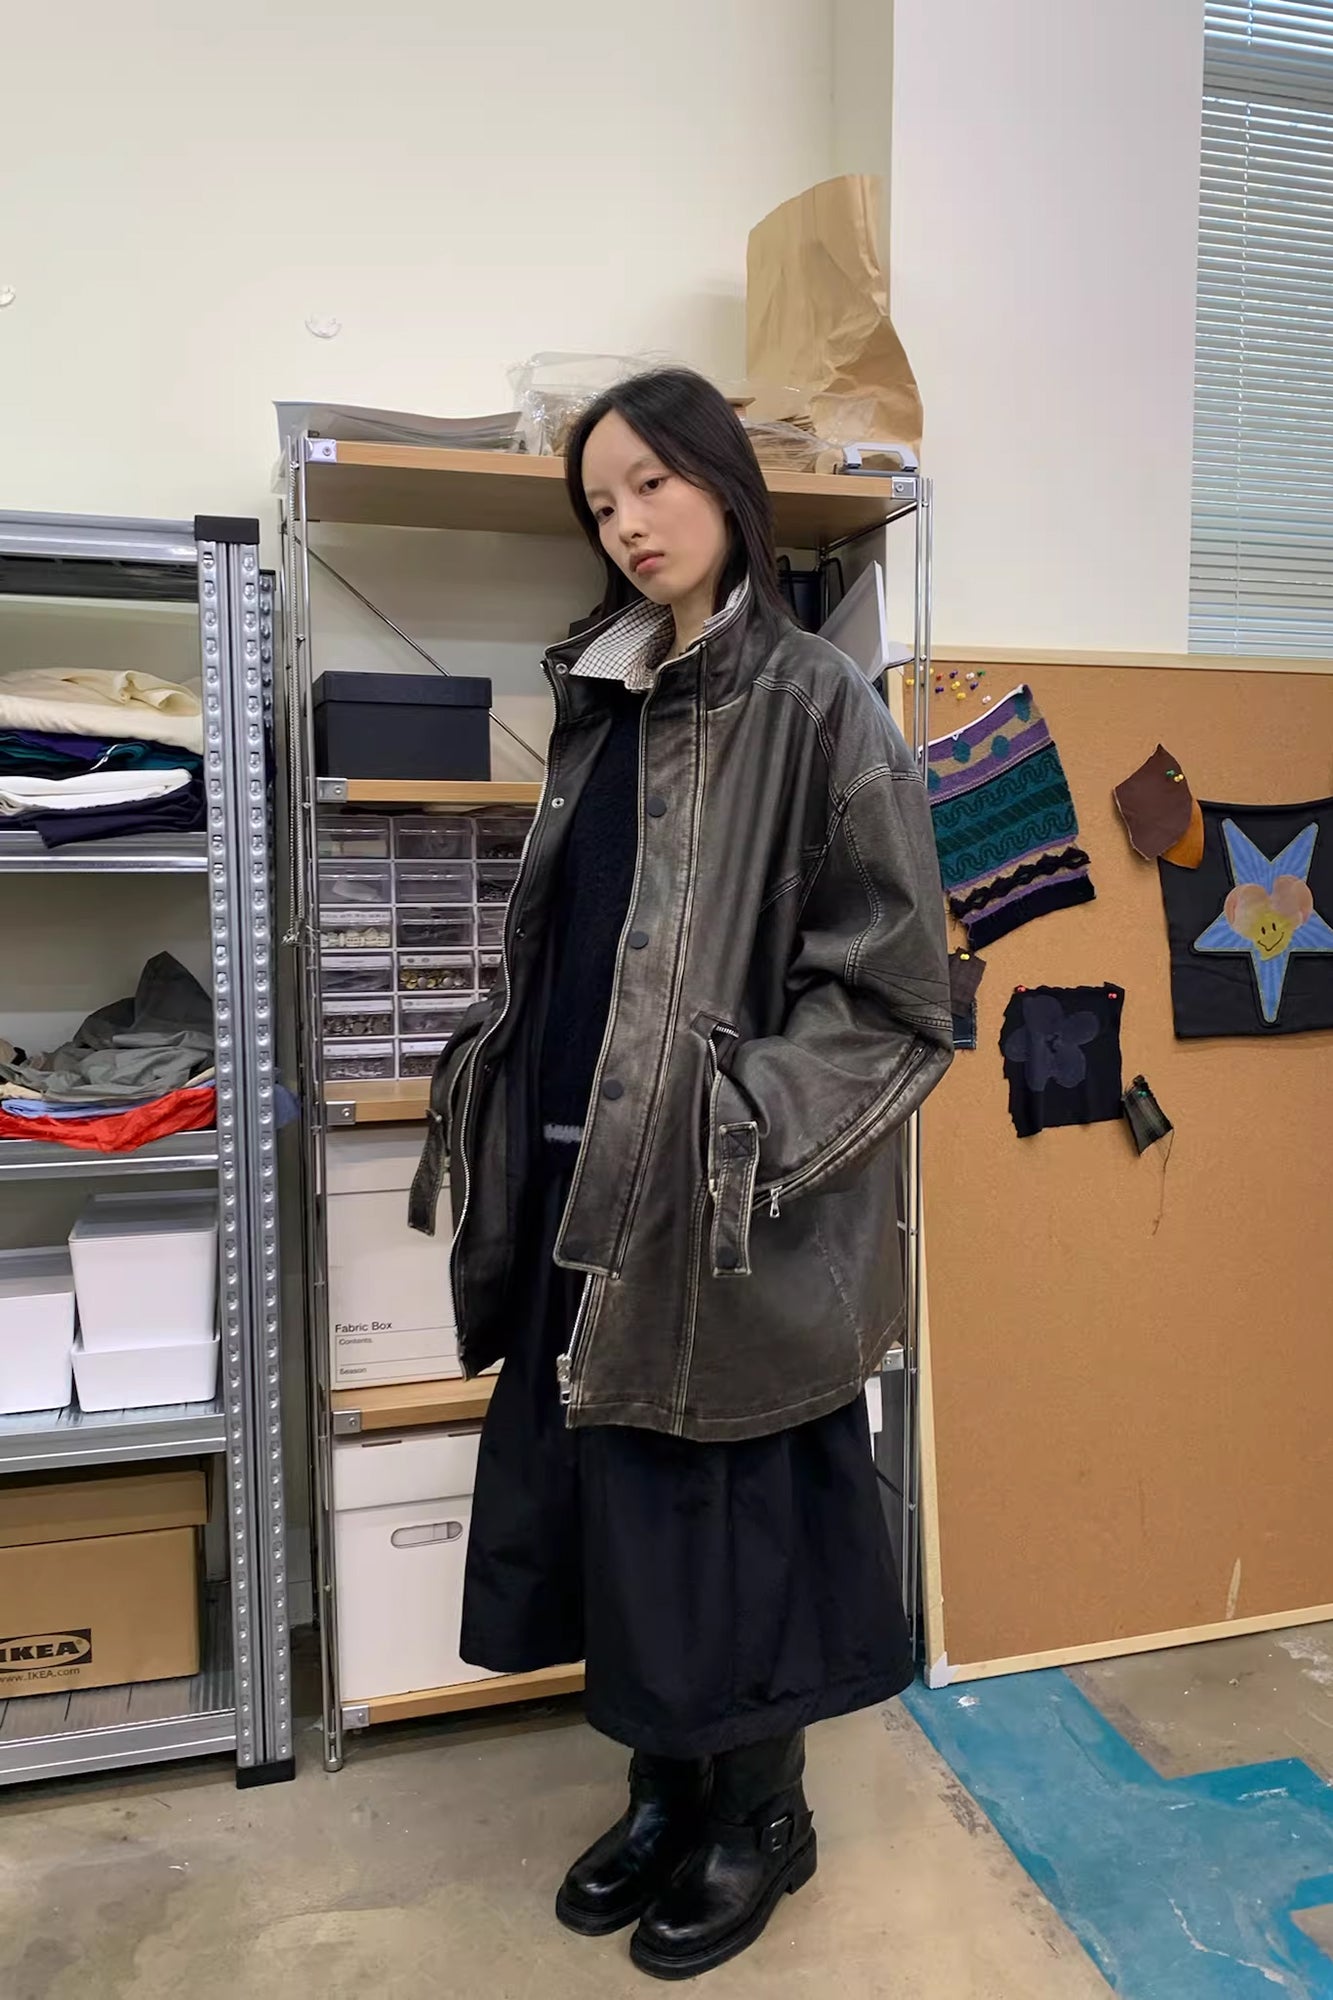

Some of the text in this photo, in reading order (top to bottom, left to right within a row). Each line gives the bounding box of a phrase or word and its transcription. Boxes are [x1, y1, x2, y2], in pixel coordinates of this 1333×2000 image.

[335, 1321, 392, 1333] Fabric Box
[0, 1641, 80, 1662] IKEA
